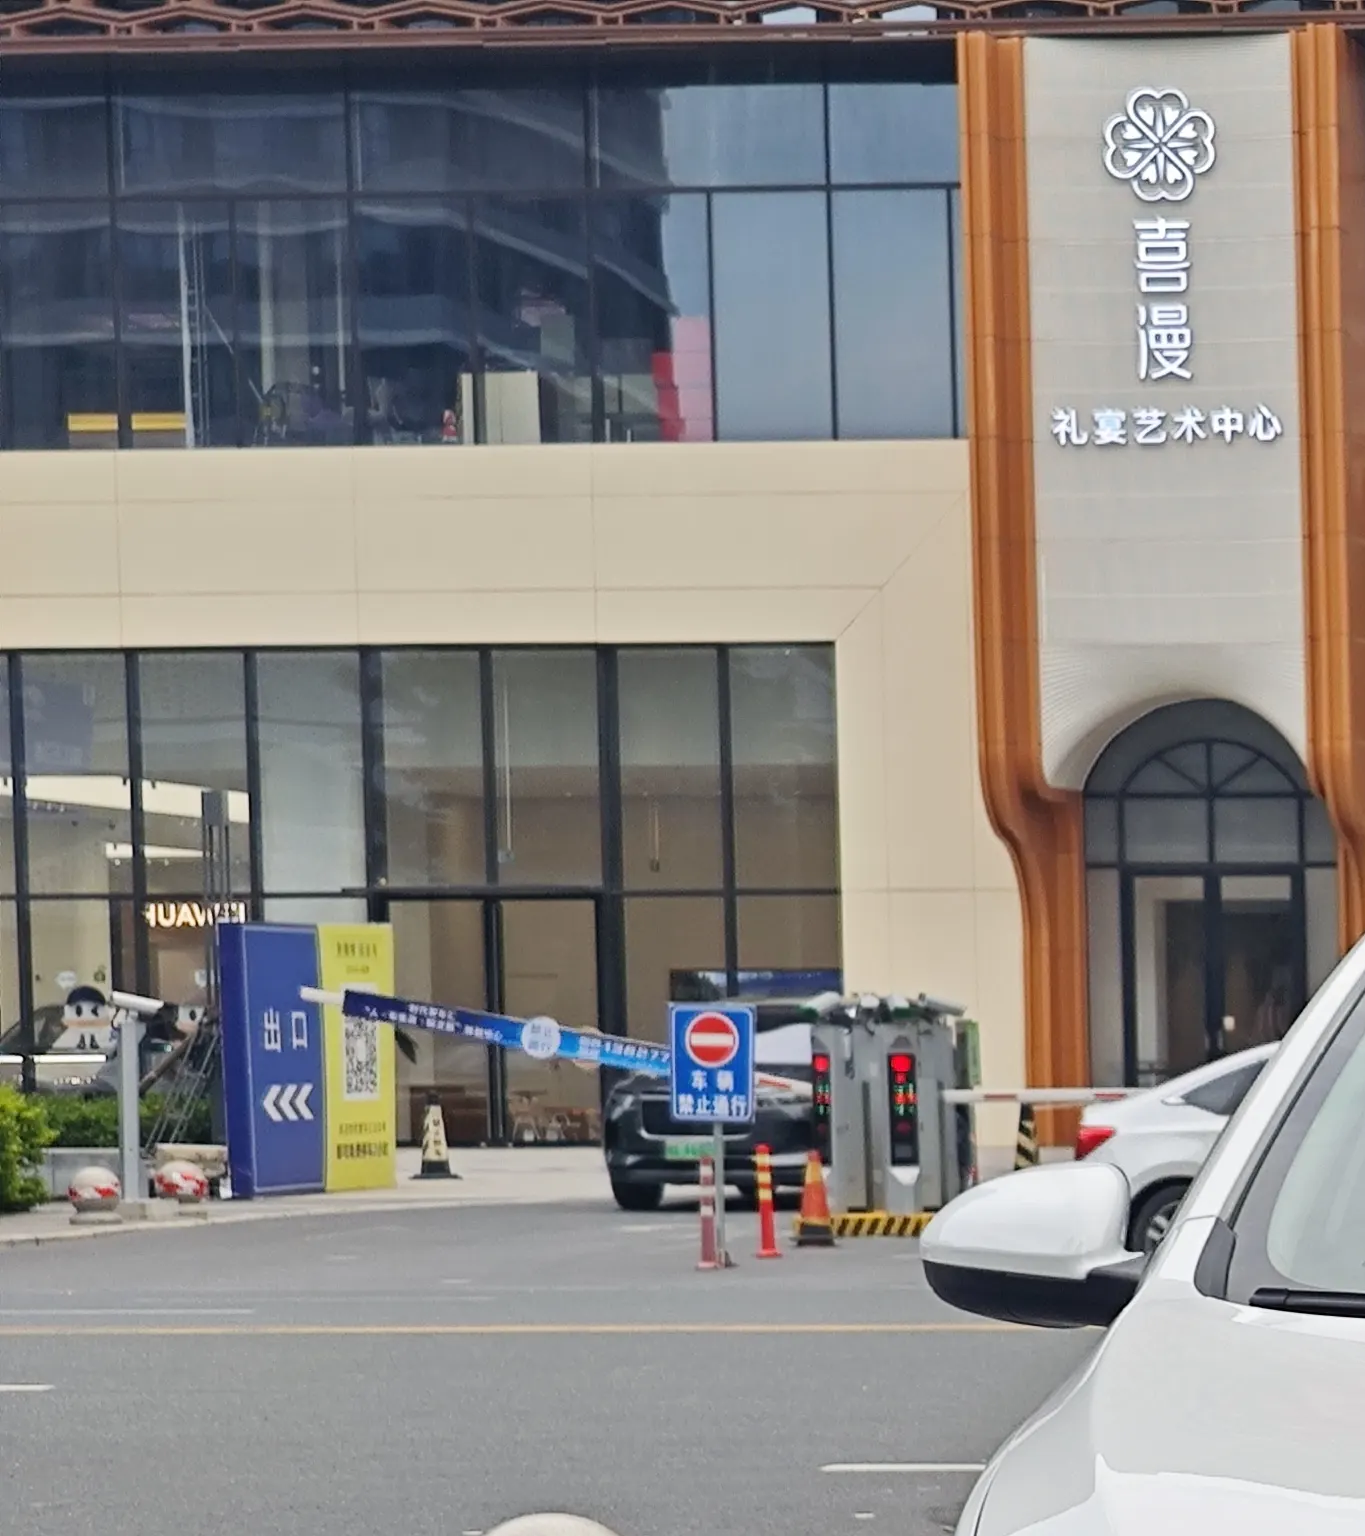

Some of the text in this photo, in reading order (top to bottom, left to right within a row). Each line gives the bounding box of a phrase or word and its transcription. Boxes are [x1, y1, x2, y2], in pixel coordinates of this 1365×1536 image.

[1132, 216, 1194, 382] 喜漫
[1051, 403, 1283, 447] 礼宴艺术中心
[263, 1007, 308, 1053] 出口
[678, 1093, 747, 1117] 禁止通行
